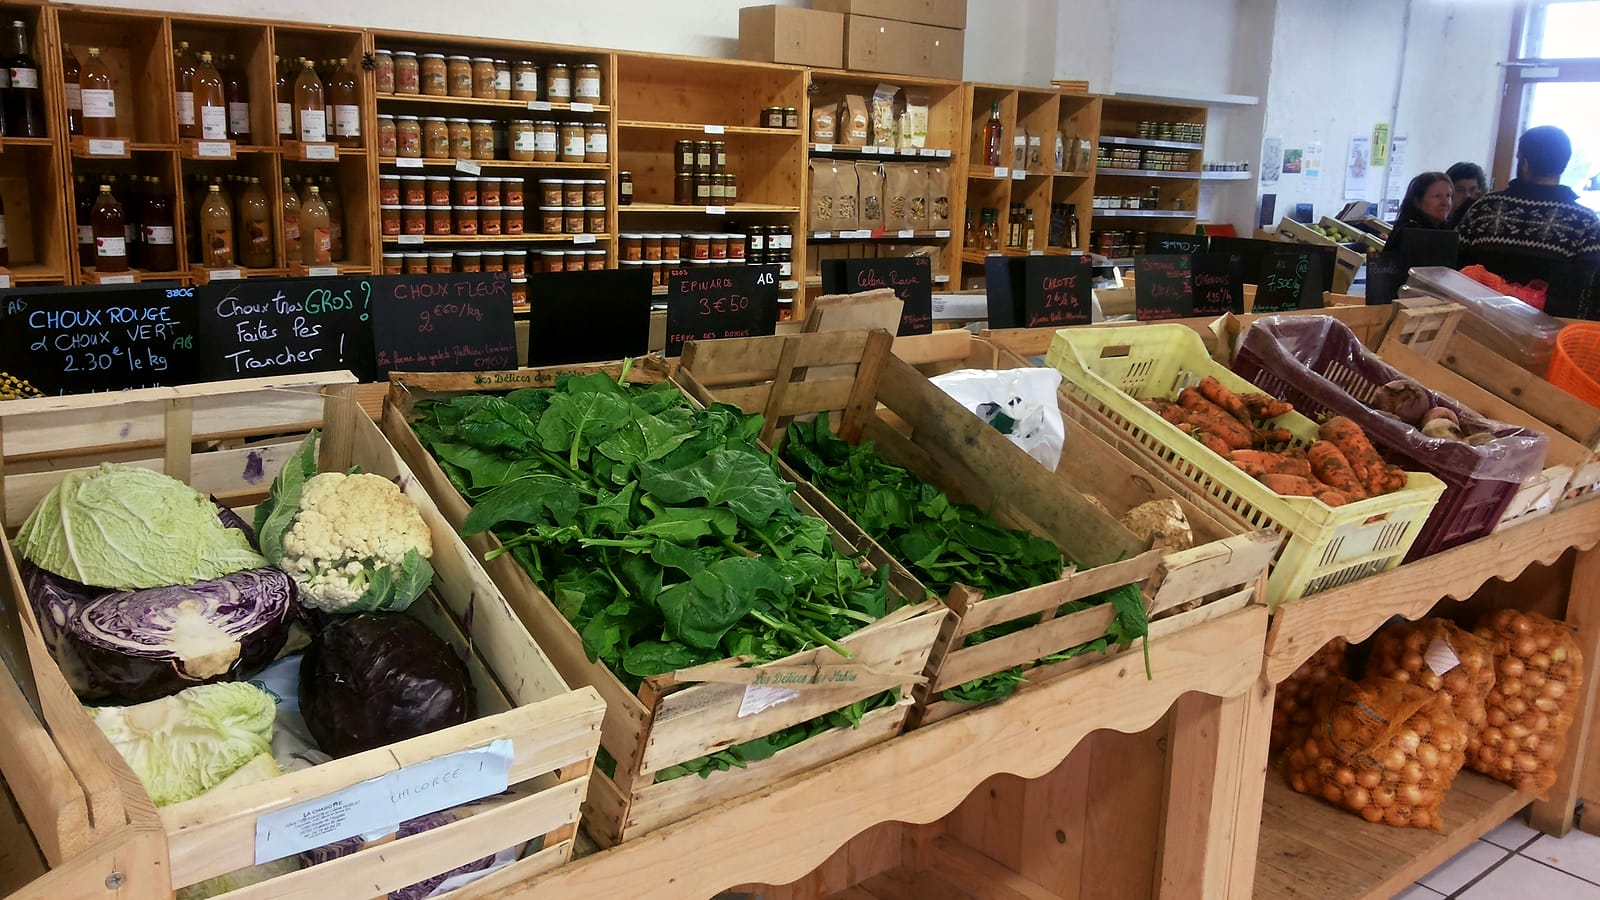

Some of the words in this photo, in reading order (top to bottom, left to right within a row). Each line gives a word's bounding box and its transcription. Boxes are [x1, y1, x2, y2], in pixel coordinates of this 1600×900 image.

[393, 283, 449, 300] CHOUX
[453, 280, 507, 298] FLEUR
[680, 278, 733, 293] EPINARDS
[756, 273, 774, 285] AB
[217, 287, 275, 318] Choux
[304, 289, 353, 314] GROS
[28, 309, 102, 329] CHOUX
[106, 306, 171, 325] ROUGE
[55, 330, 111, 352] CHOUX
[126, 321, 181, 343] VERT
[236, 320, 279, 342] Faites
[147, 346, 168, 371] kg
[224, 346, 323, 373] Trancher
